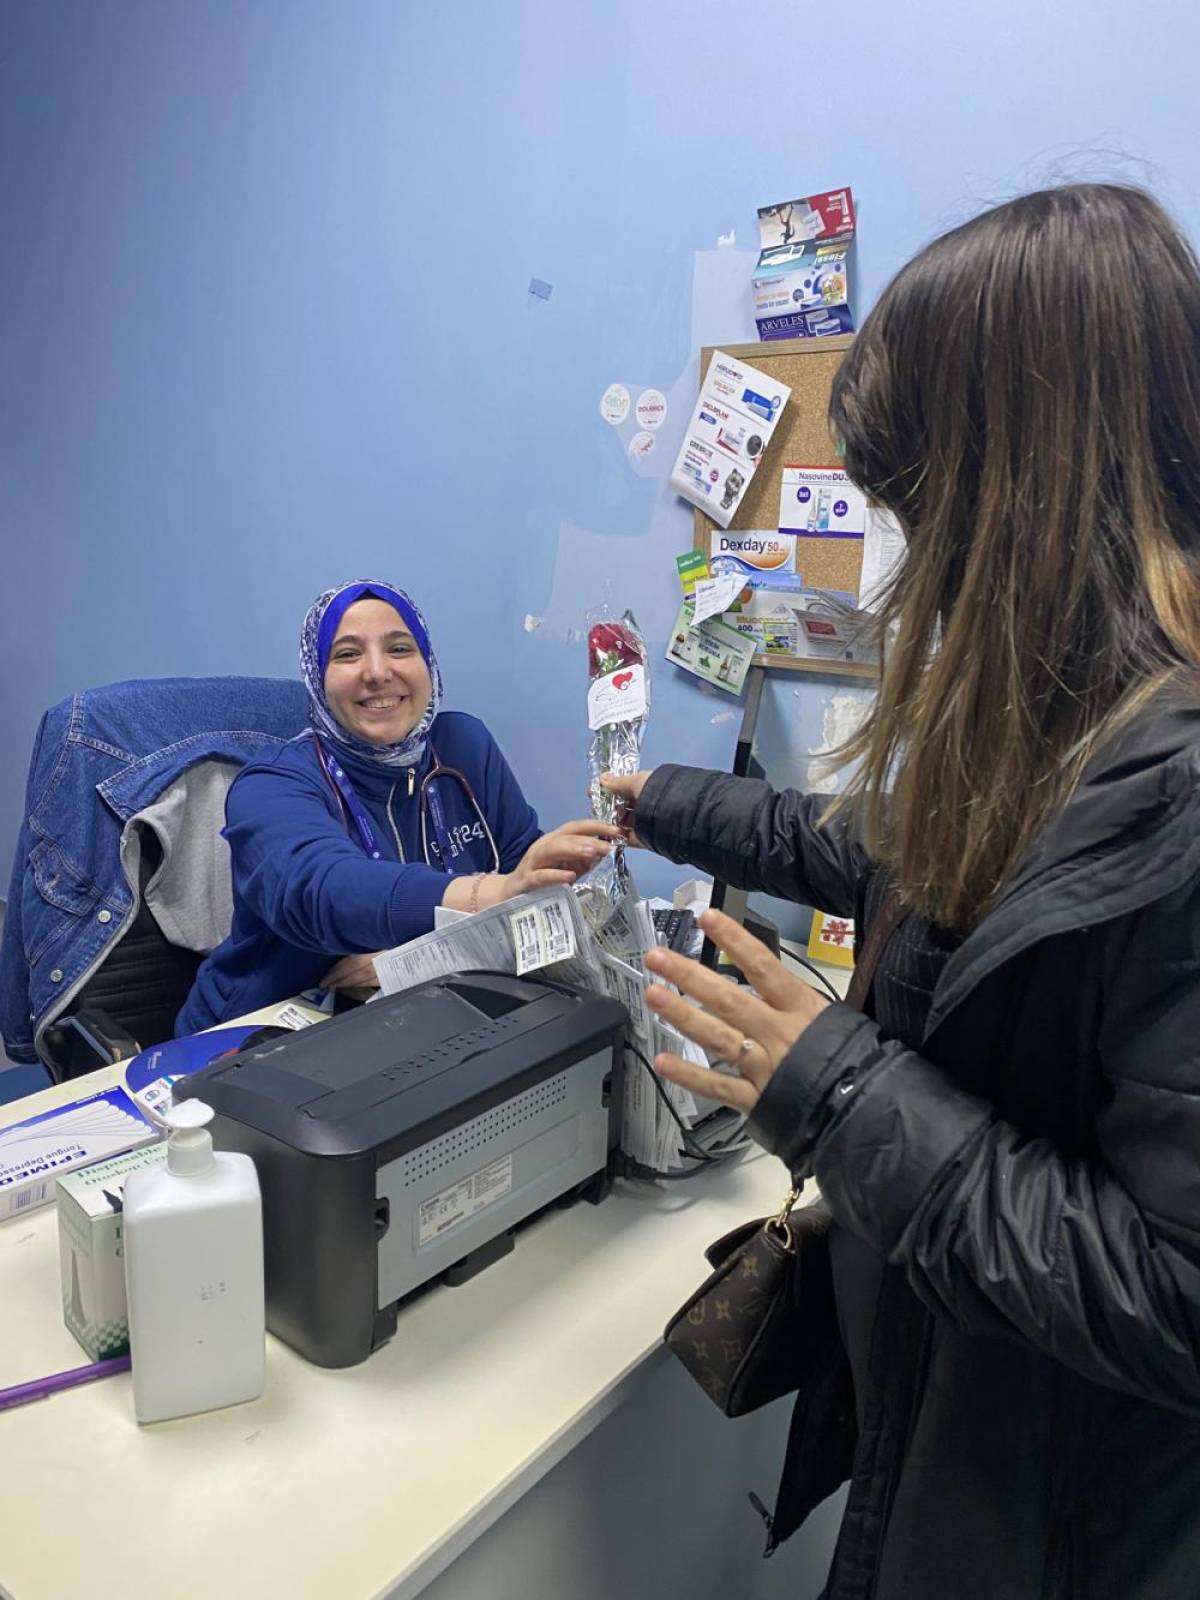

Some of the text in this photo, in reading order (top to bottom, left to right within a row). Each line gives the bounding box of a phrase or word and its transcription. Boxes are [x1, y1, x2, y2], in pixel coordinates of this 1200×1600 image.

[760, 315, 804, 332] ARVELES
[720, 537, 779, 554] Dexday 50
[46, 1144, 82, 1159] Tongue
[0, 1150, 86, 1186] EPIMED
